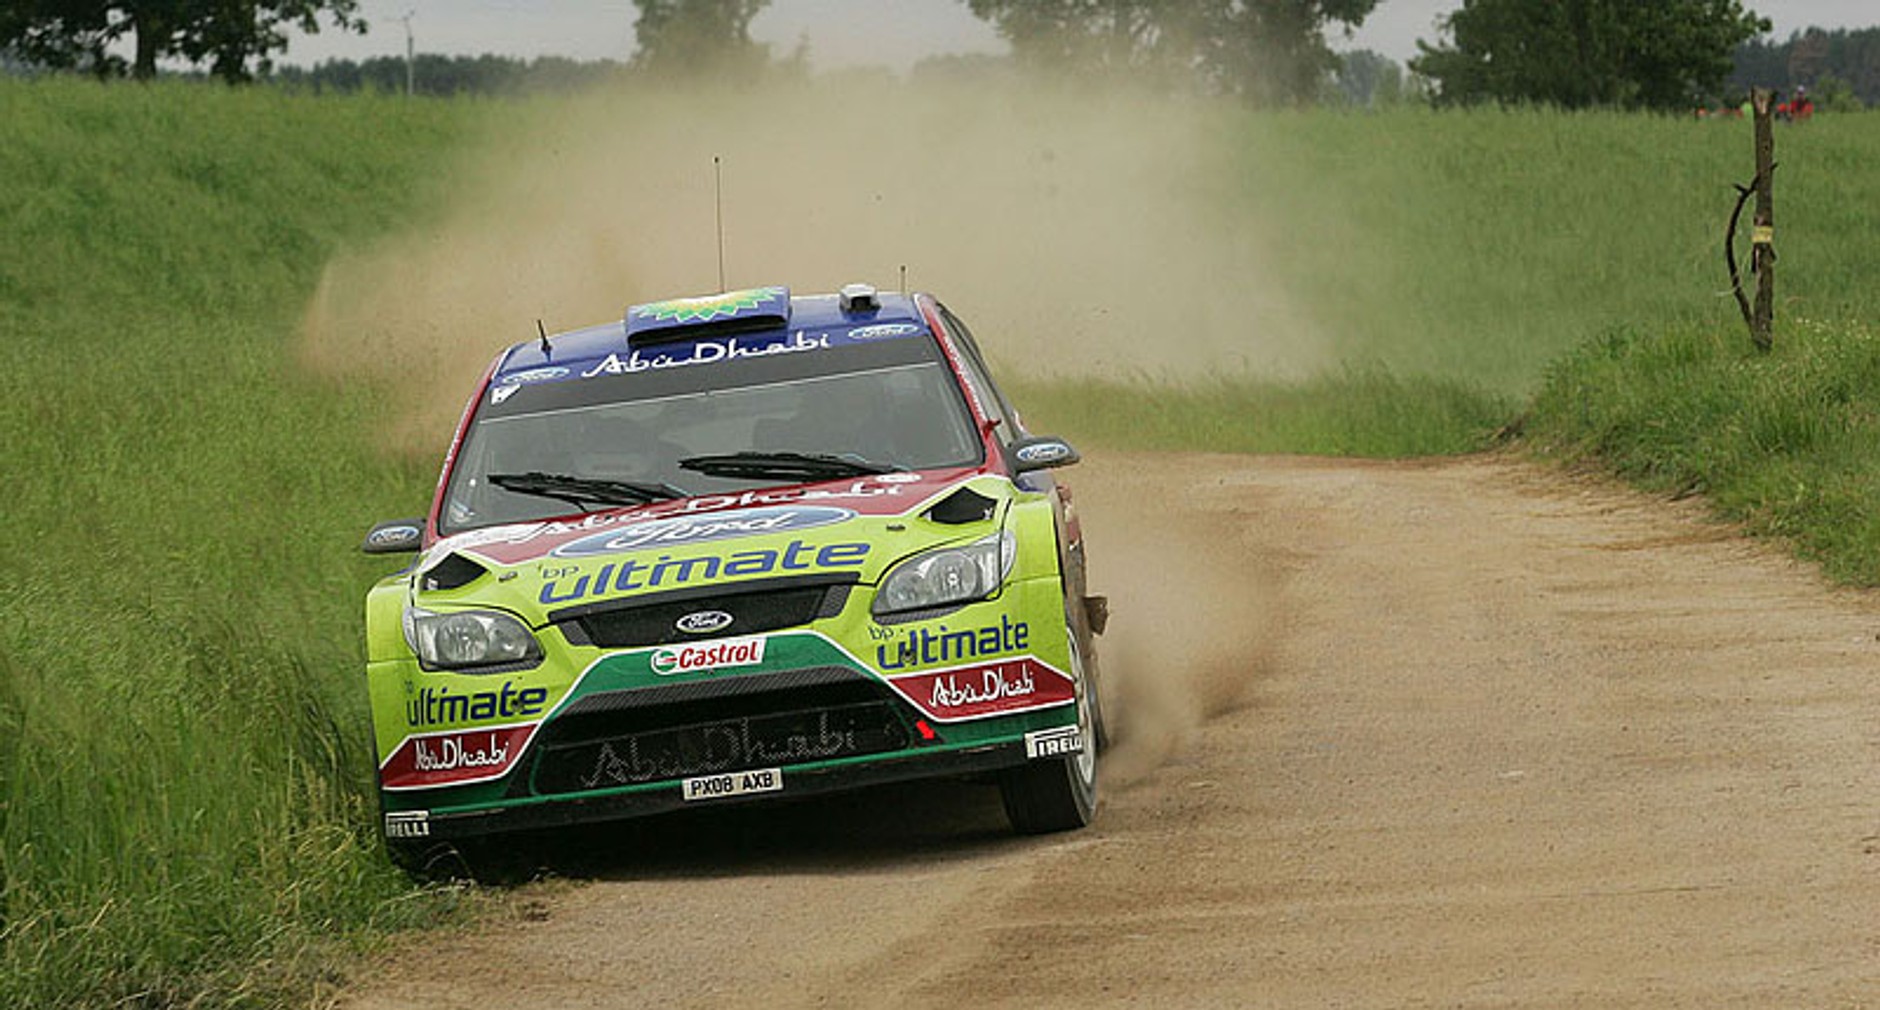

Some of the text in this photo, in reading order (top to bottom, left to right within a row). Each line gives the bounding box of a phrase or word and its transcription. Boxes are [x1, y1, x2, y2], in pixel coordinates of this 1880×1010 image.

[582, 331, 832, 378] Abu Dhabi
[684, 481, 902, 514] Dhabi
[605, 511, 798, 549] Ford
[539, 541, 872, 604] ultimate
[542, 565, 581, 579] bp
[868, 624, 895, 641] bp
[876, 613, 1030, 670] ultimate
[678, 641, 758, 669] Castrol
[406, 681, 548, 726] ultimate
[928, 662, 1035, 708] Abu Dhabi
[442, 733, 510, 768] Dhabi
[700, 711, 858, 774] Dhabi
[690, 767, 774, 797] PX08 AXB
